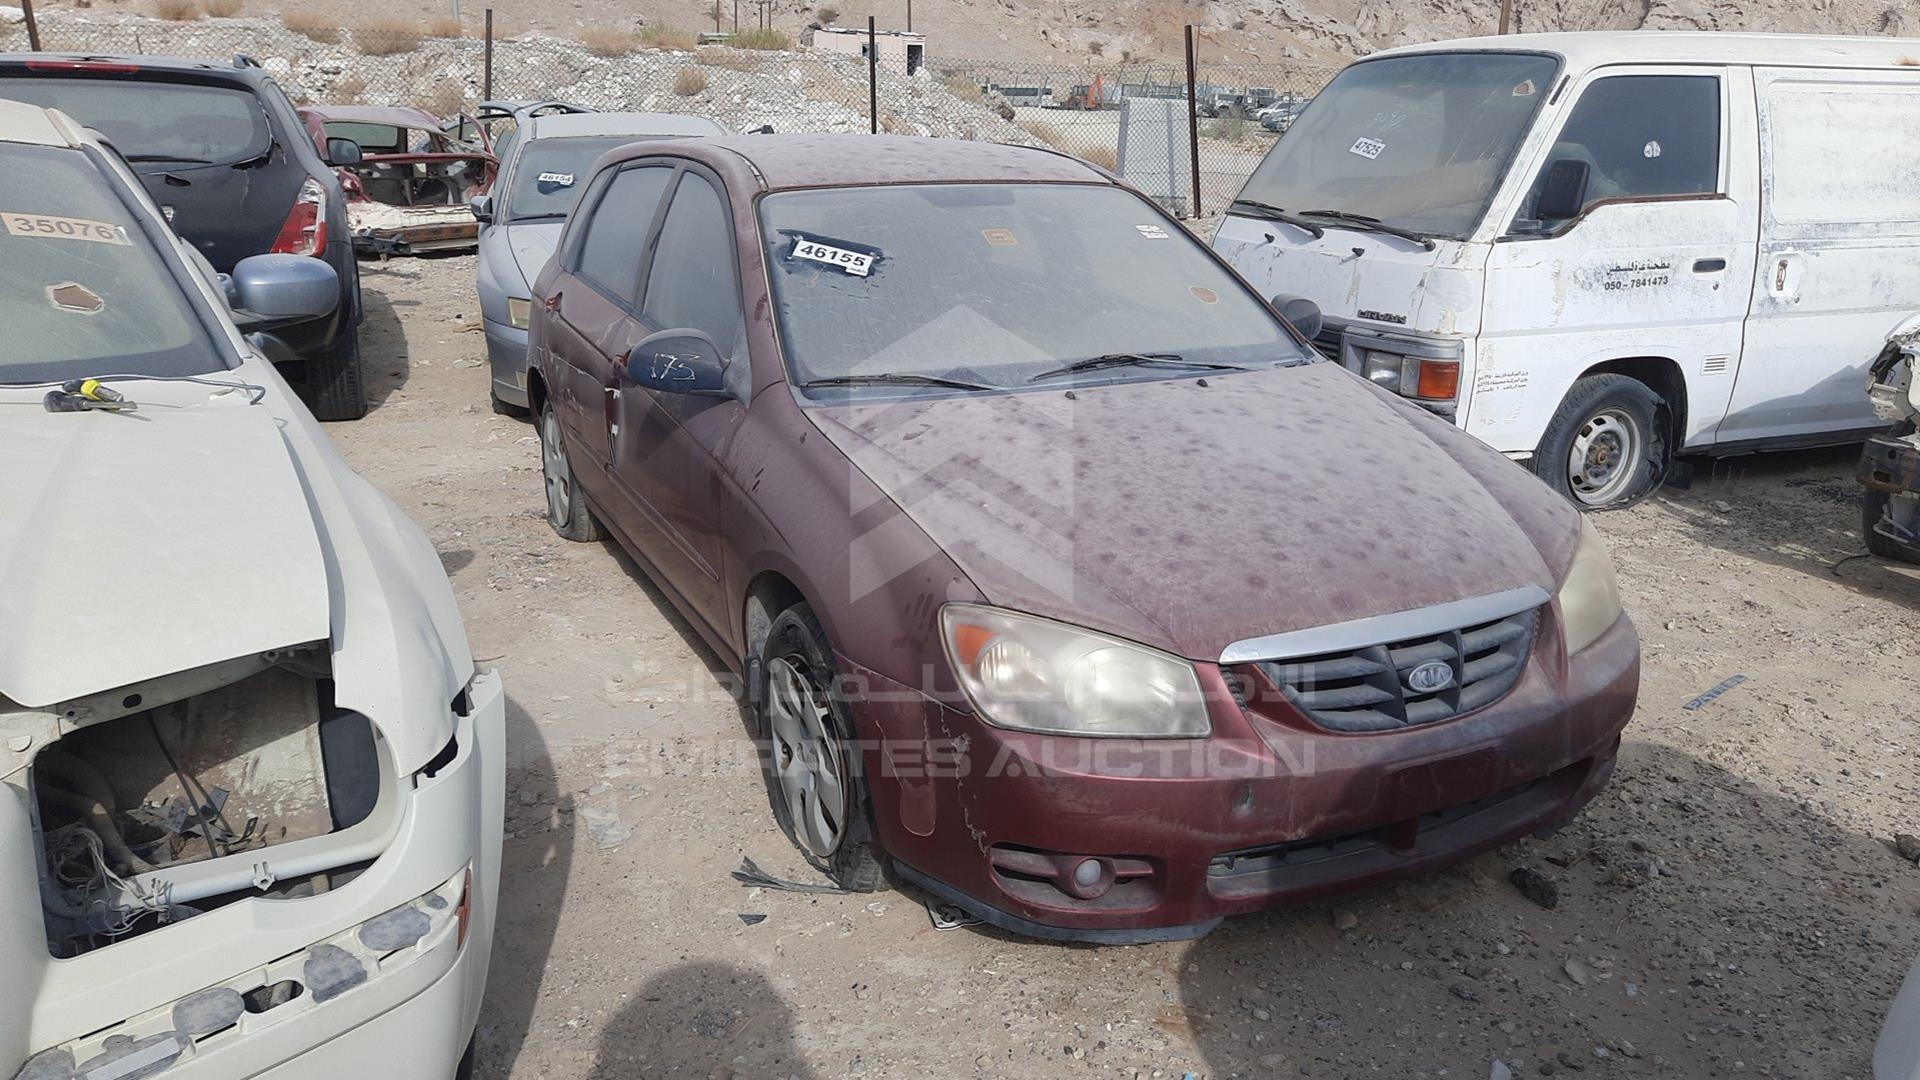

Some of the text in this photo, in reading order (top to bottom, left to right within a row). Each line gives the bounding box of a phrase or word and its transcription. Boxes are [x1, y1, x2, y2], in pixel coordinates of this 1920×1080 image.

[1354, 141, 1383, 156] 47525
[13, 217, 114, 240] 35076
[799, 244, 867, 267] 46155
[1604, 280, 1622, 291] 050
[1630, 275, 1669, 288] 7841473
